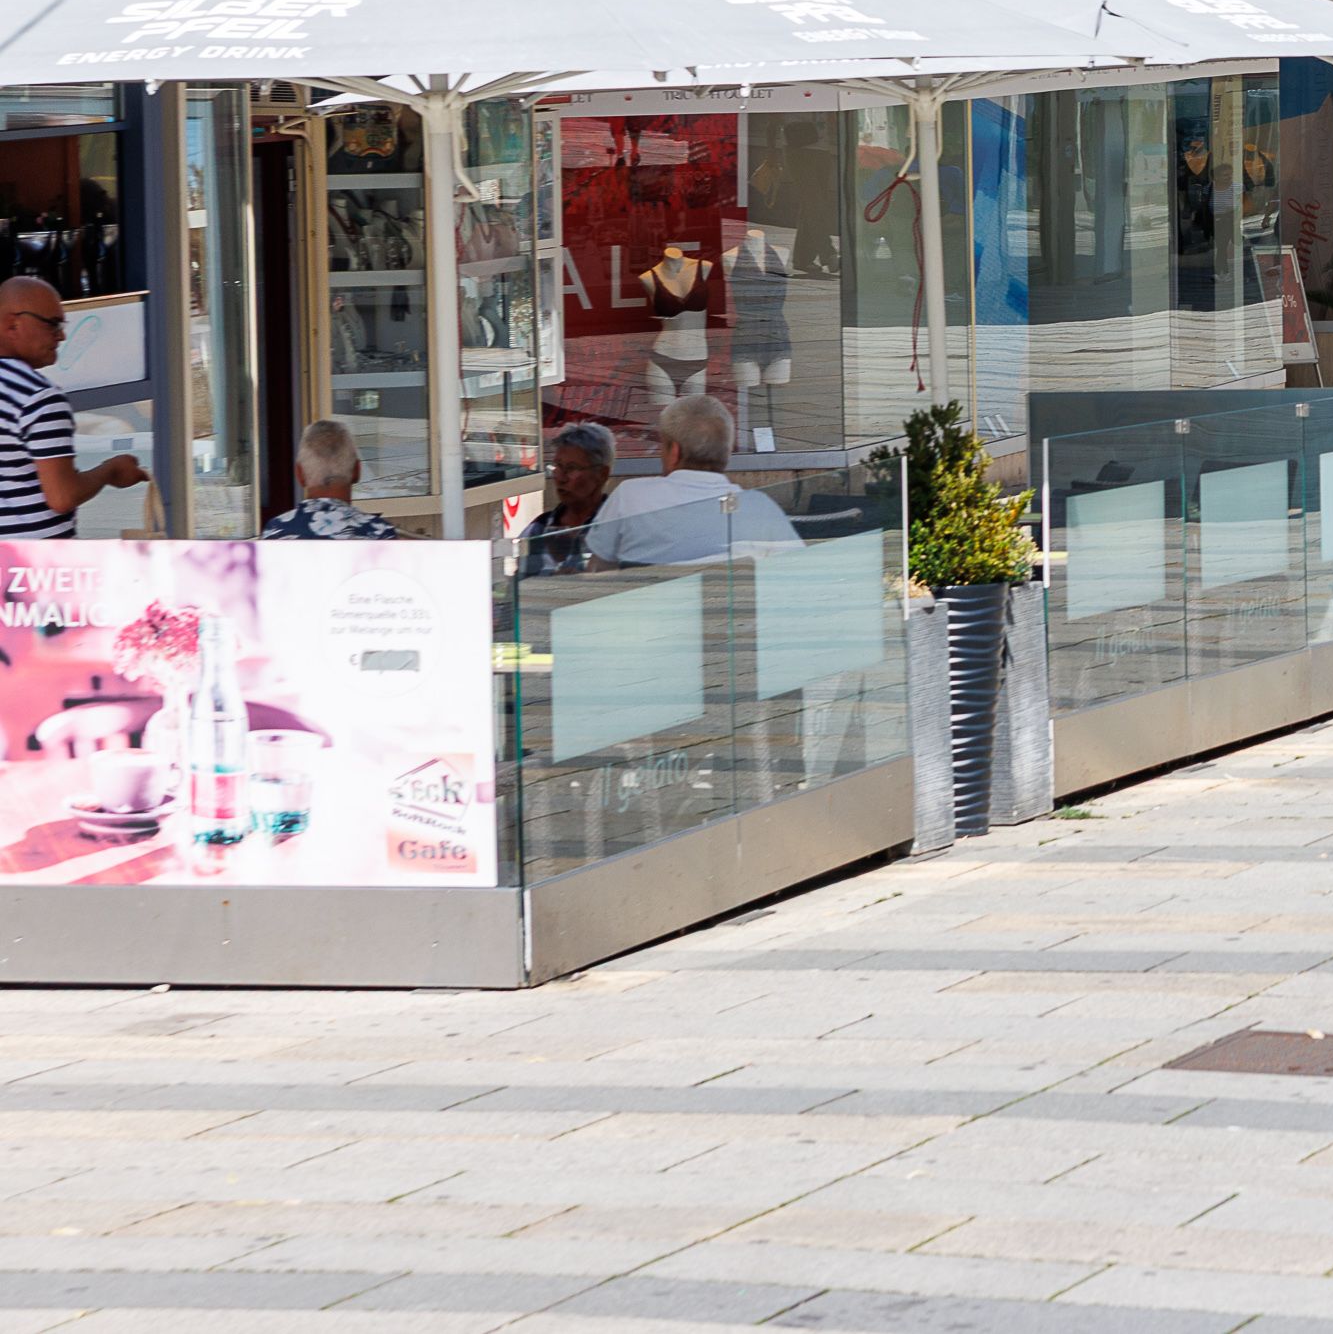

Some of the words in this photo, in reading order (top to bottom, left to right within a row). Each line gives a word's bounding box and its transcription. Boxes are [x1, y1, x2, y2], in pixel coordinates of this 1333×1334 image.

[120, 16, 314, 44] PFEIL
[56, 45, 195, 66] ENERGY
[198, 45, 313, 59] DRINK
